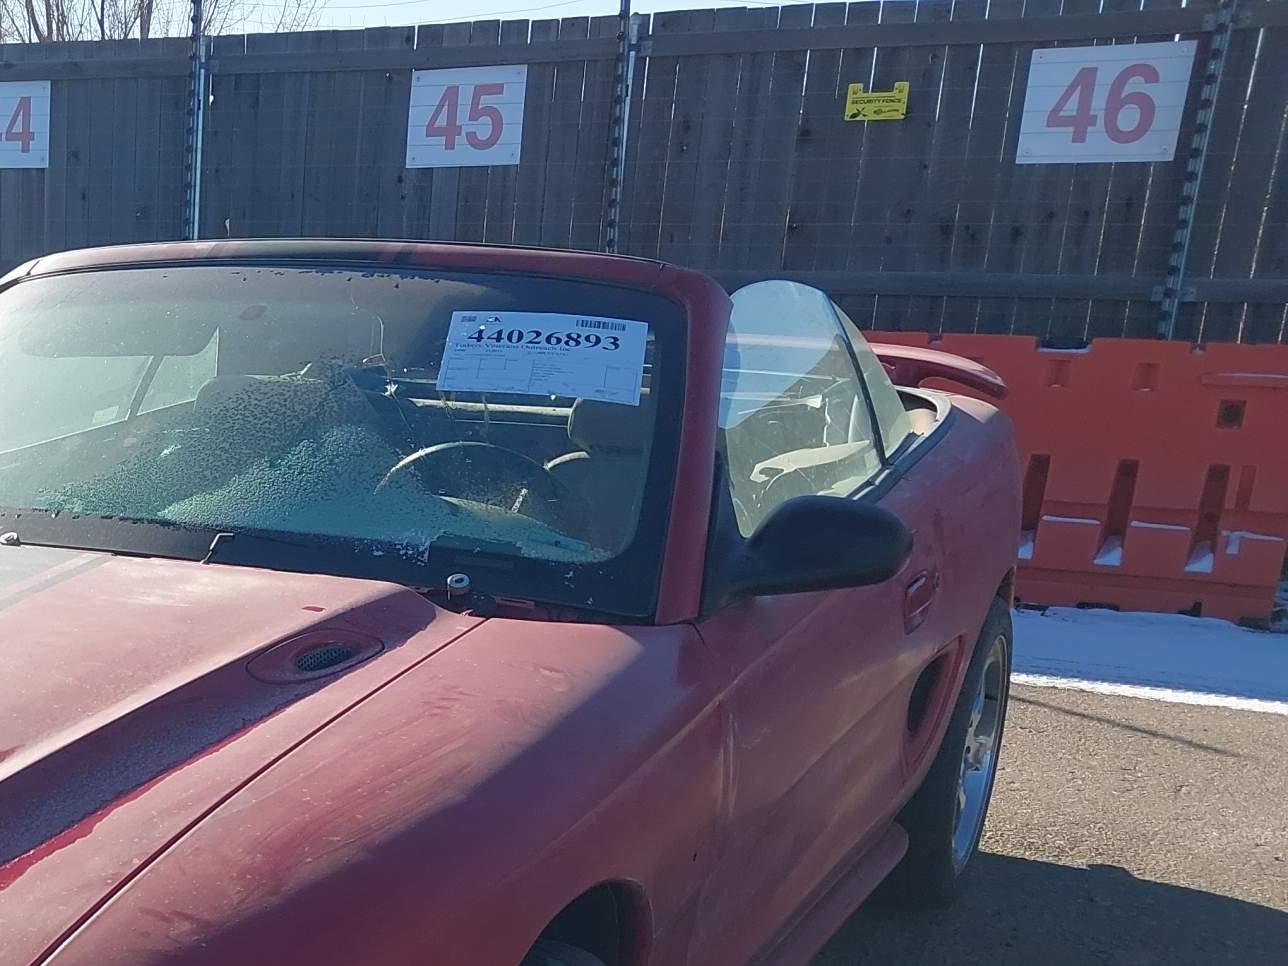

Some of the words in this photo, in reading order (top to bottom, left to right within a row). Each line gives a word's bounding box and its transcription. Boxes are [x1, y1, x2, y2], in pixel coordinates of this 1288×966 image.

[425, 83, 505, 151] 45
[1047, 63, 1160, 144] 46
[468, 328, 620, 351] 44026893
